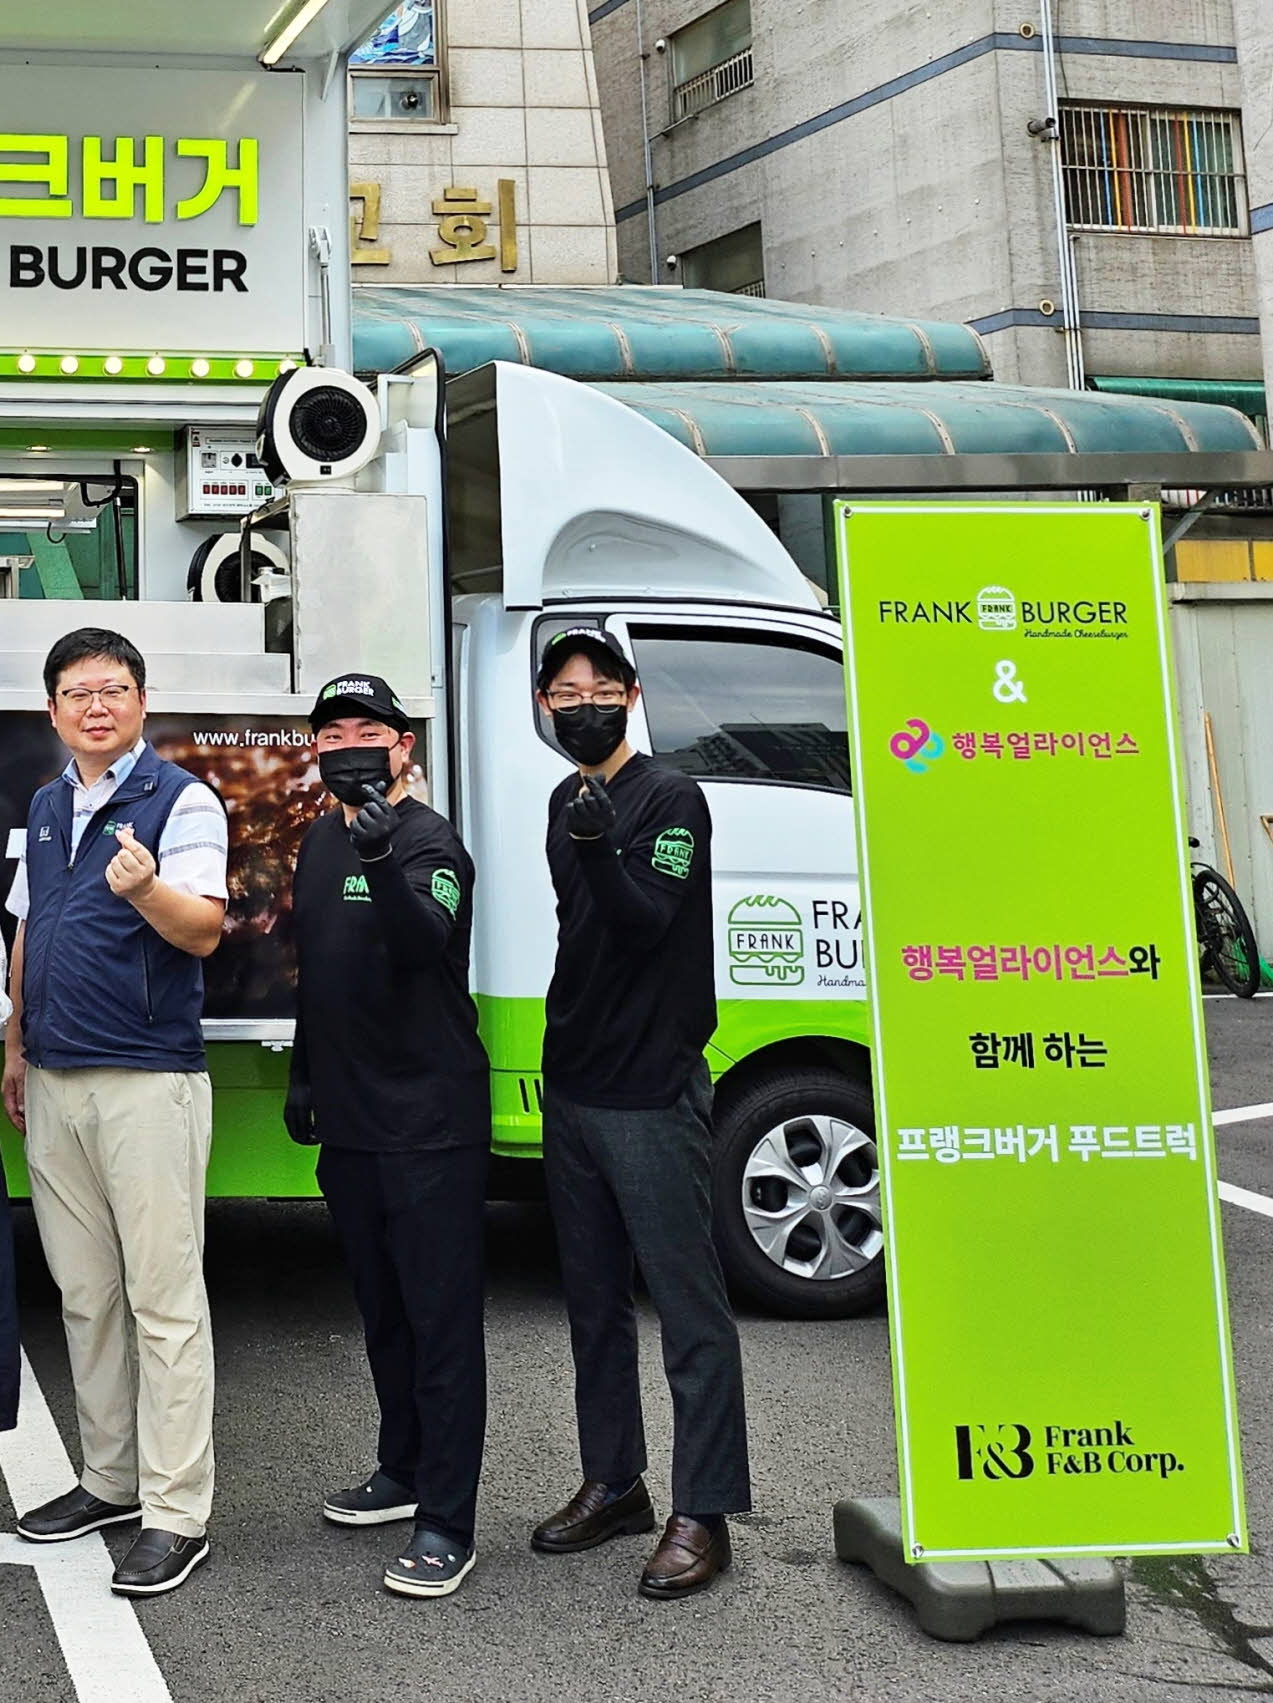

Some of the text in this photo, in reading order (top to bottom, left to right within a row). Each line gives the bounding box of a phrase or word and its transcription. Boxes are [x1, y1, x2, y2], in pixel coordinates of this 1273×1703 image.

[9, 244, 249, 293] BURGER
[879, 600, 1128, 624] FRANK FRANK BURGER
[1024, 628, 1129, 641] Handmade Cheeseburger
[336, 680, 371, 689] FRANK
[993, 659, 1027, 703] &
[193, 729, 317, 747] www.frankbu
[952, 732, 1139, 760] 행복얼라이언스
[736, 933, 795, 950] FRANK
[901, 945, 1161, 981] 행복얼라이언스와
[817, 974, 867, 987] Handma
[969, 1032, 1108, 1069] 함께 하는
[896, 1122, 1197, 1164] 프랭크버거 푸드트럭
[1045, 1420, 1135, 1448] Frank
[1047, 1449, 1185, 1479] F&B Corp.
